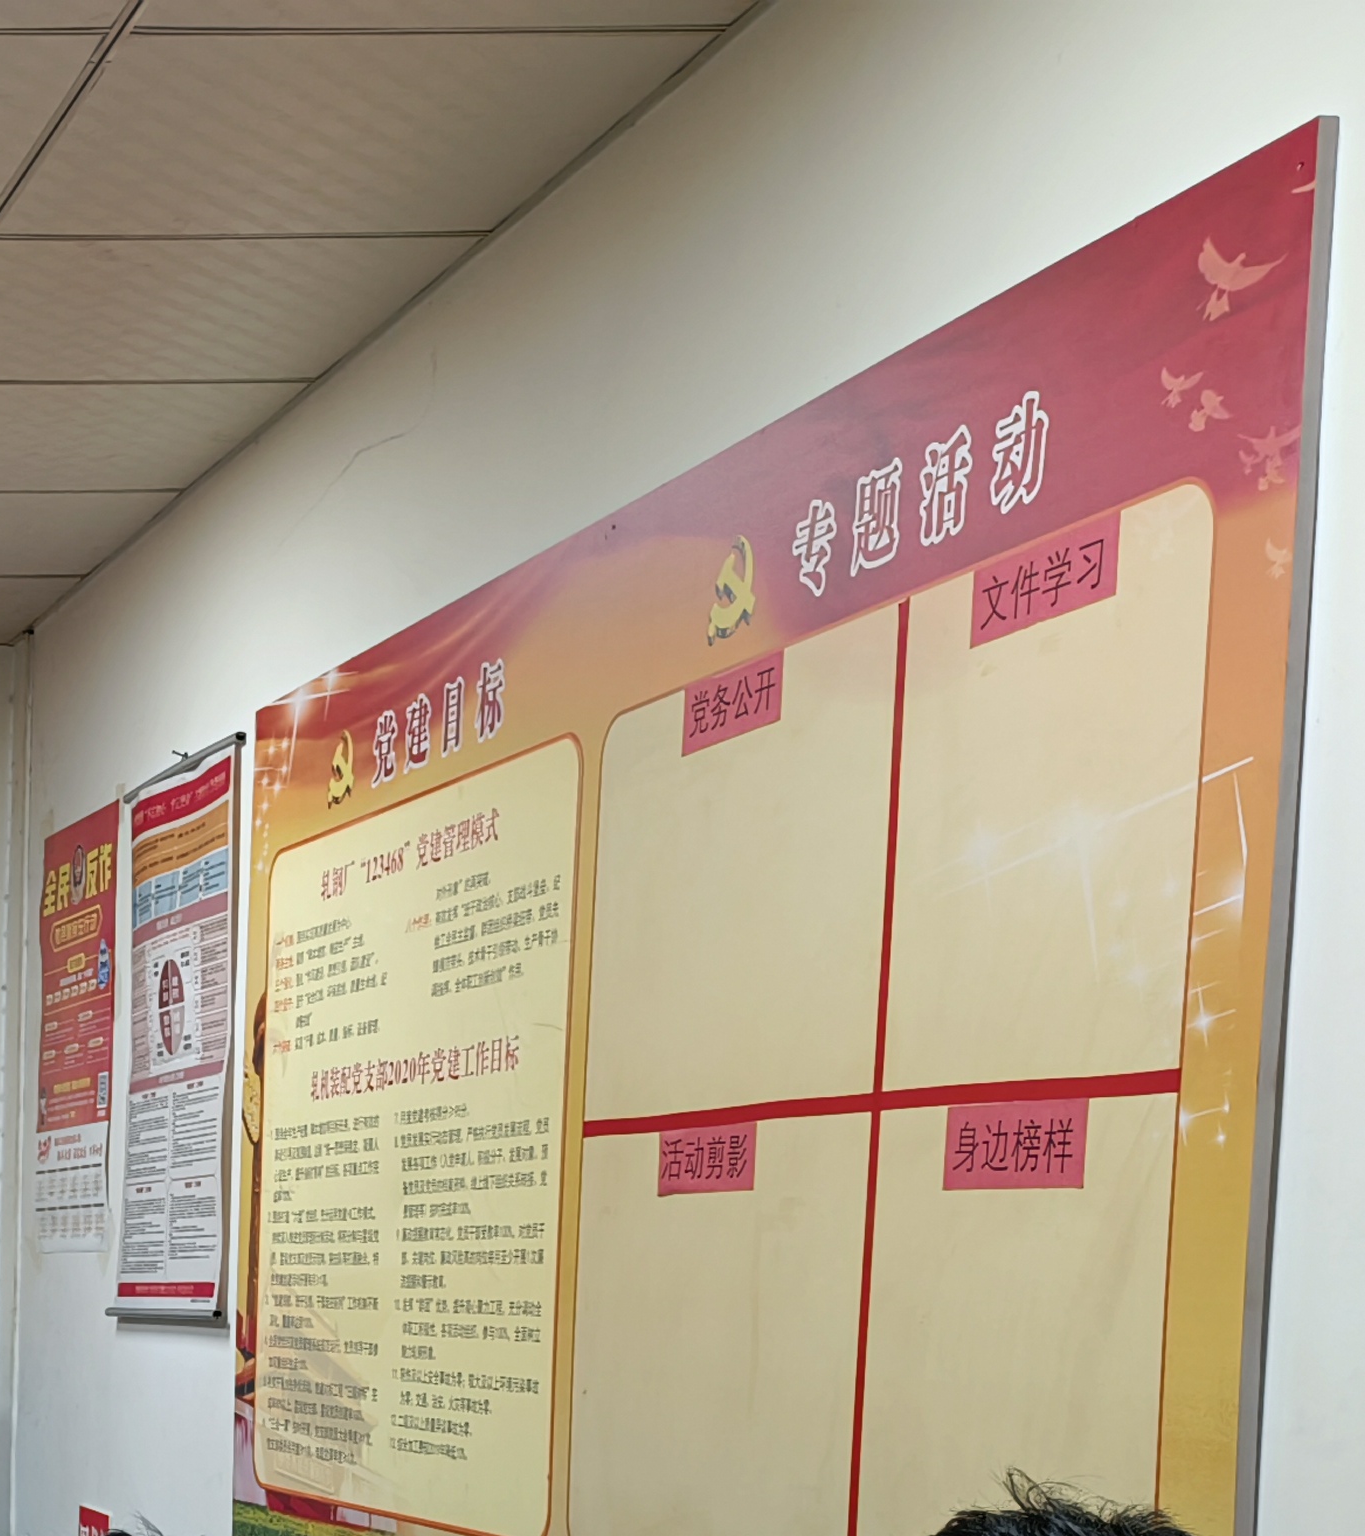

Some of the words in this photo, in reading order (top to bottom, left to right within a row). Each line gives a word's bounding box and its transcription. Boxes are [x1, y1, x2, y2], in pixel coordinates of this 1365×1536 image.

[793, 391, 1051, 598] 专题活动
[981, 536, 1108, 630] 文件学习
[370, 659, 506, 788] 党建目标
[689, 666, 778, 739] 党务公开
[42, 863, 70, 917] 全民
[85, 844, 112, 899] 反诈
[660, 1136, 749, 1184] 活动剪影
[953, 1119, 1075, 1177] 身边榜样
